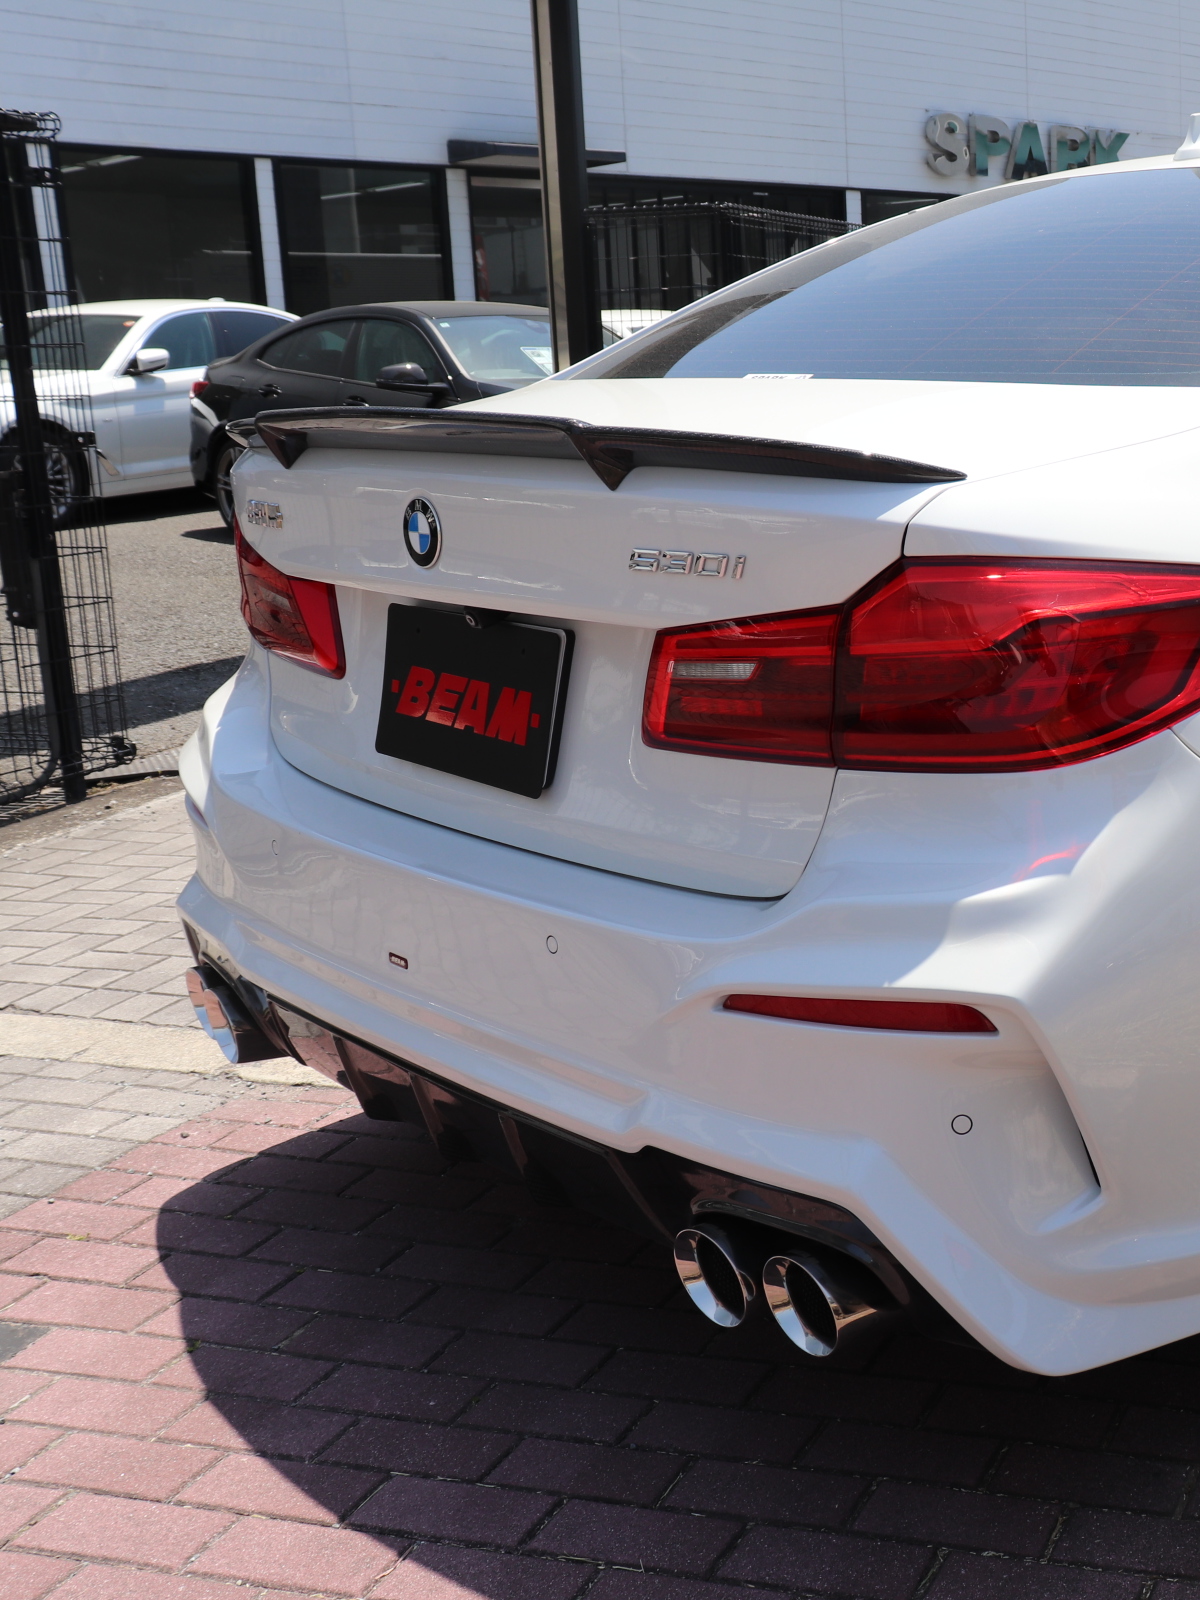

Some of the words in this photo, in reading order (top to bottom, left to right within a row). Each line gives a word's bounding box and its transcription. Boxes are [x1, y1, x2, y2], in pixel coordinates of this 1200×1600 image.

[925, 113, 1130, 181] SPARK
[405, 499, 435, 523] BMW
[628, 547, 747, 580] 530i
[395, 665, 532, 746] BEAM
